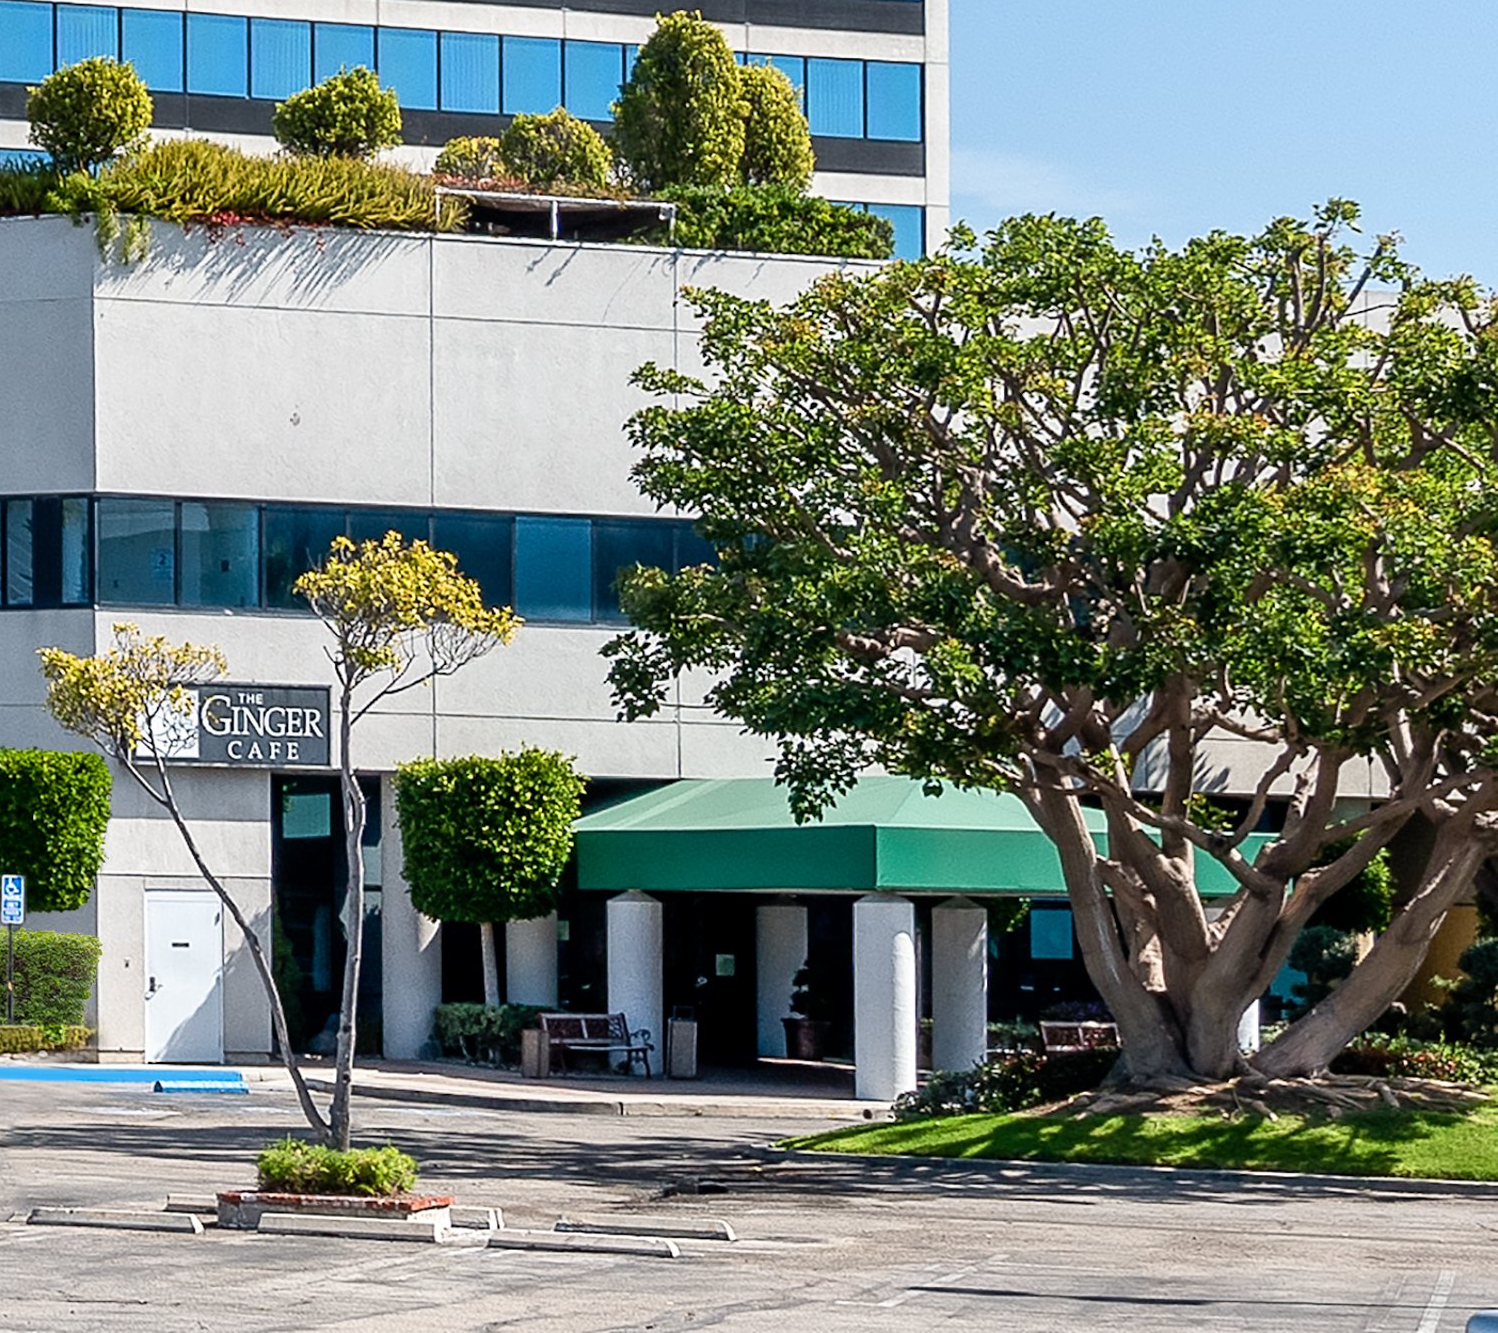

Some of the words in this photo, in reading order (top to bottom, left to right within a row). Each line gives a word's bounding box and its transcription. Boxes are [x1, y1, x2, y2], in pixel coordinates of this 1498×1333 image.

[238, 692, 264, 705] THE
[201, 694, 324, 738] GINGER
[227, 740, 299, 760] CAFE
